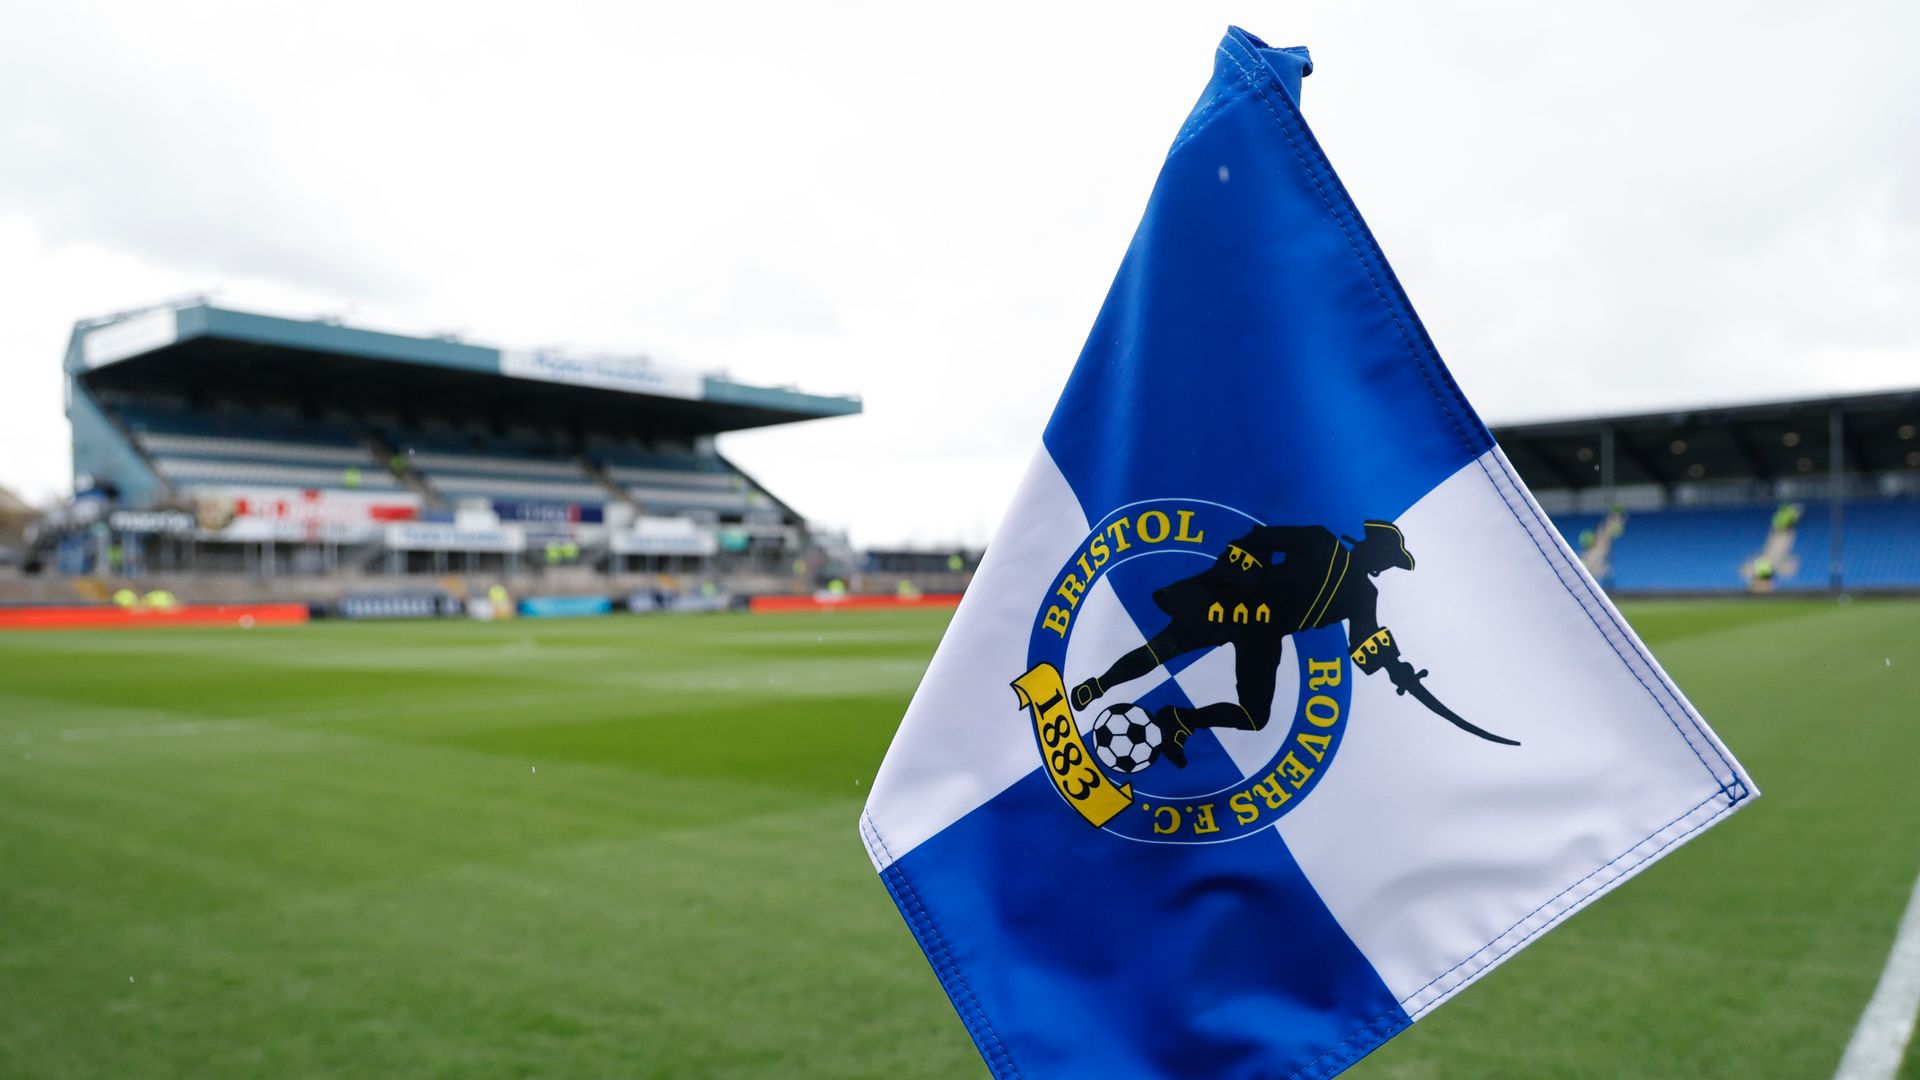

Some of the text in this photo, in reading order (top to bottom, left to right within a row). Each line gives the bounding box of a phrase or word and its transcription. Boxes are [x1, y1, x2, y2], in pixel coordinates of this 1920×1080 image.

[1042, 510, 1204, 639] BRISTOL
[1034, 687, 1100, 801] 1883
[1142, 657, 1342, 835] ROVERS F.C.
